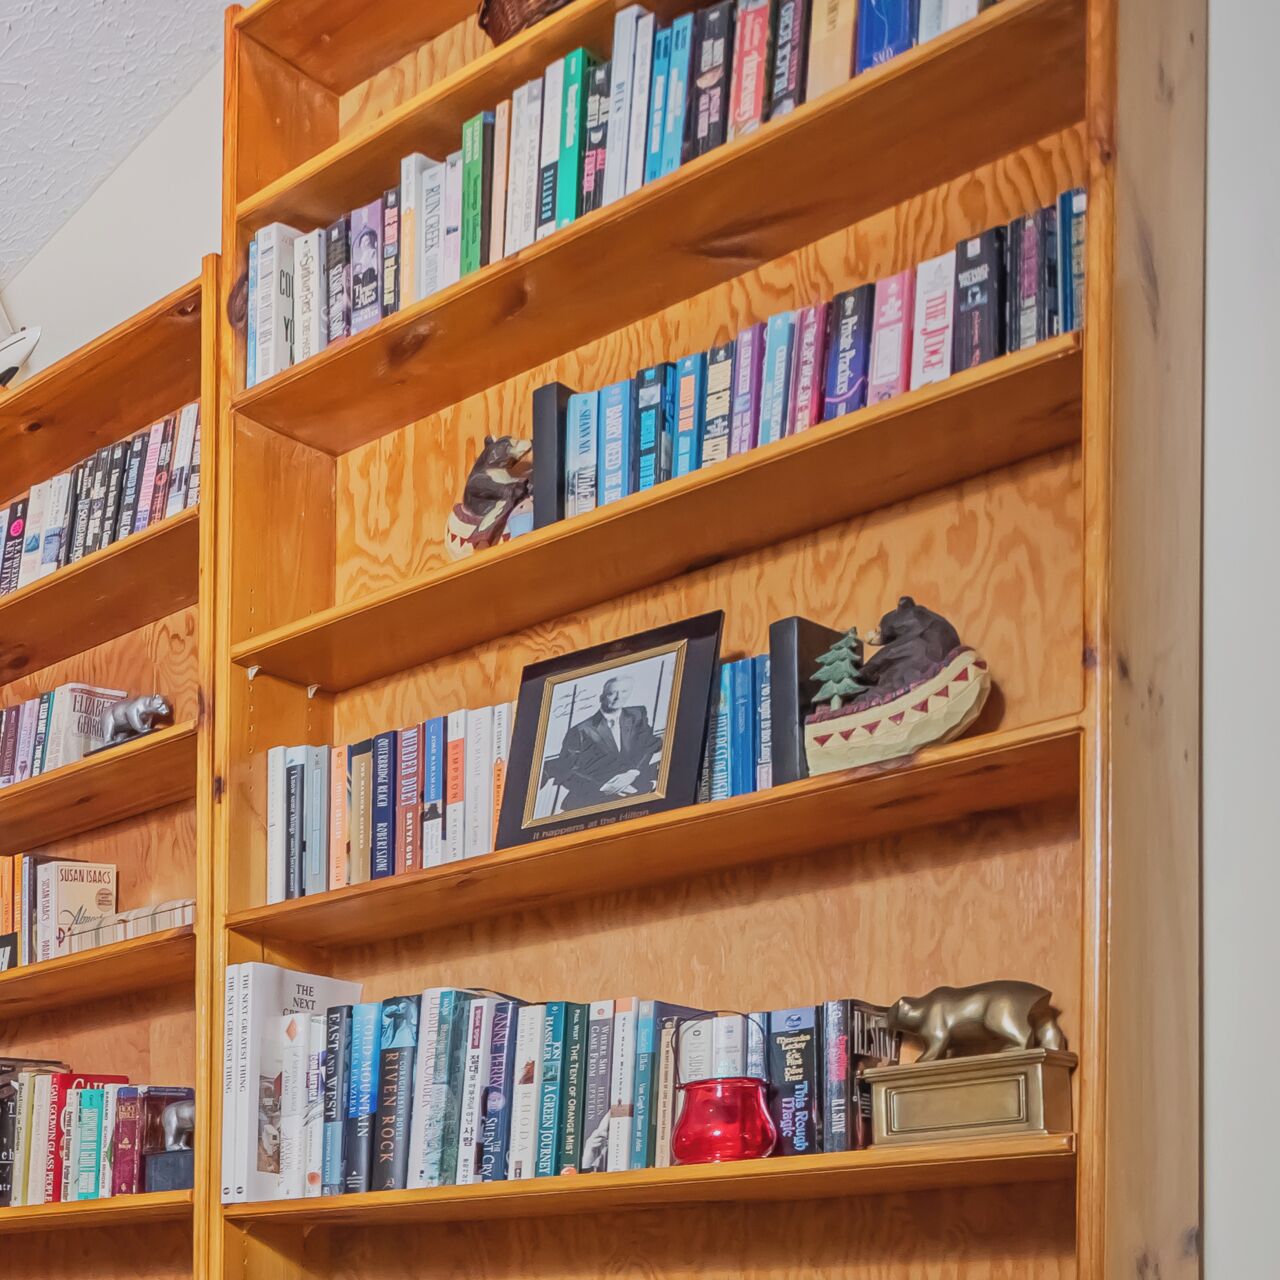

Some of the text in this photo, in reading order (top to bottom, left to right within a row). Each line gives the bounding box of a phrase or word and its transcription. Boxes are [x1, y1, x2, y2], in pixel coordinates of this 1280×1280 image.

[542, 170, 554, 220] BEATTIE
[921, 291, 949, 374] THE JUDGE
[606, 442, 622, 469] REED
[400, 728, 418, 808] MURDER DUET
[450, 743, 461, 800] SIMPSON
[41, 878, 50, 922] SUSAN ISAACS
[60, 868, 111, 884] SUSAN ISAACS
[292, 997, 316, 1010] NEXT
[296, 984, 314, 997] THE
[325, 1013, 340, 1119] EAST AND WEST
[357, 1015, 373, 1137] COLD MOUNTAIN
[588, 1026, 599, 1077] CAME FROM
[48, 1104, 57, 1140] GODWIN
[380, 1053, 399, 1163] RIVEN ROCK
[780, 1097, 793, 1137] Magic
[793, 1081, 808, 1150] This Rough
[47, 1142, 56, 1170] GLASS
[482, 1118, 498, 1176] SILENT CRY
[44, 1172, 54, 1201] PEOPLE
